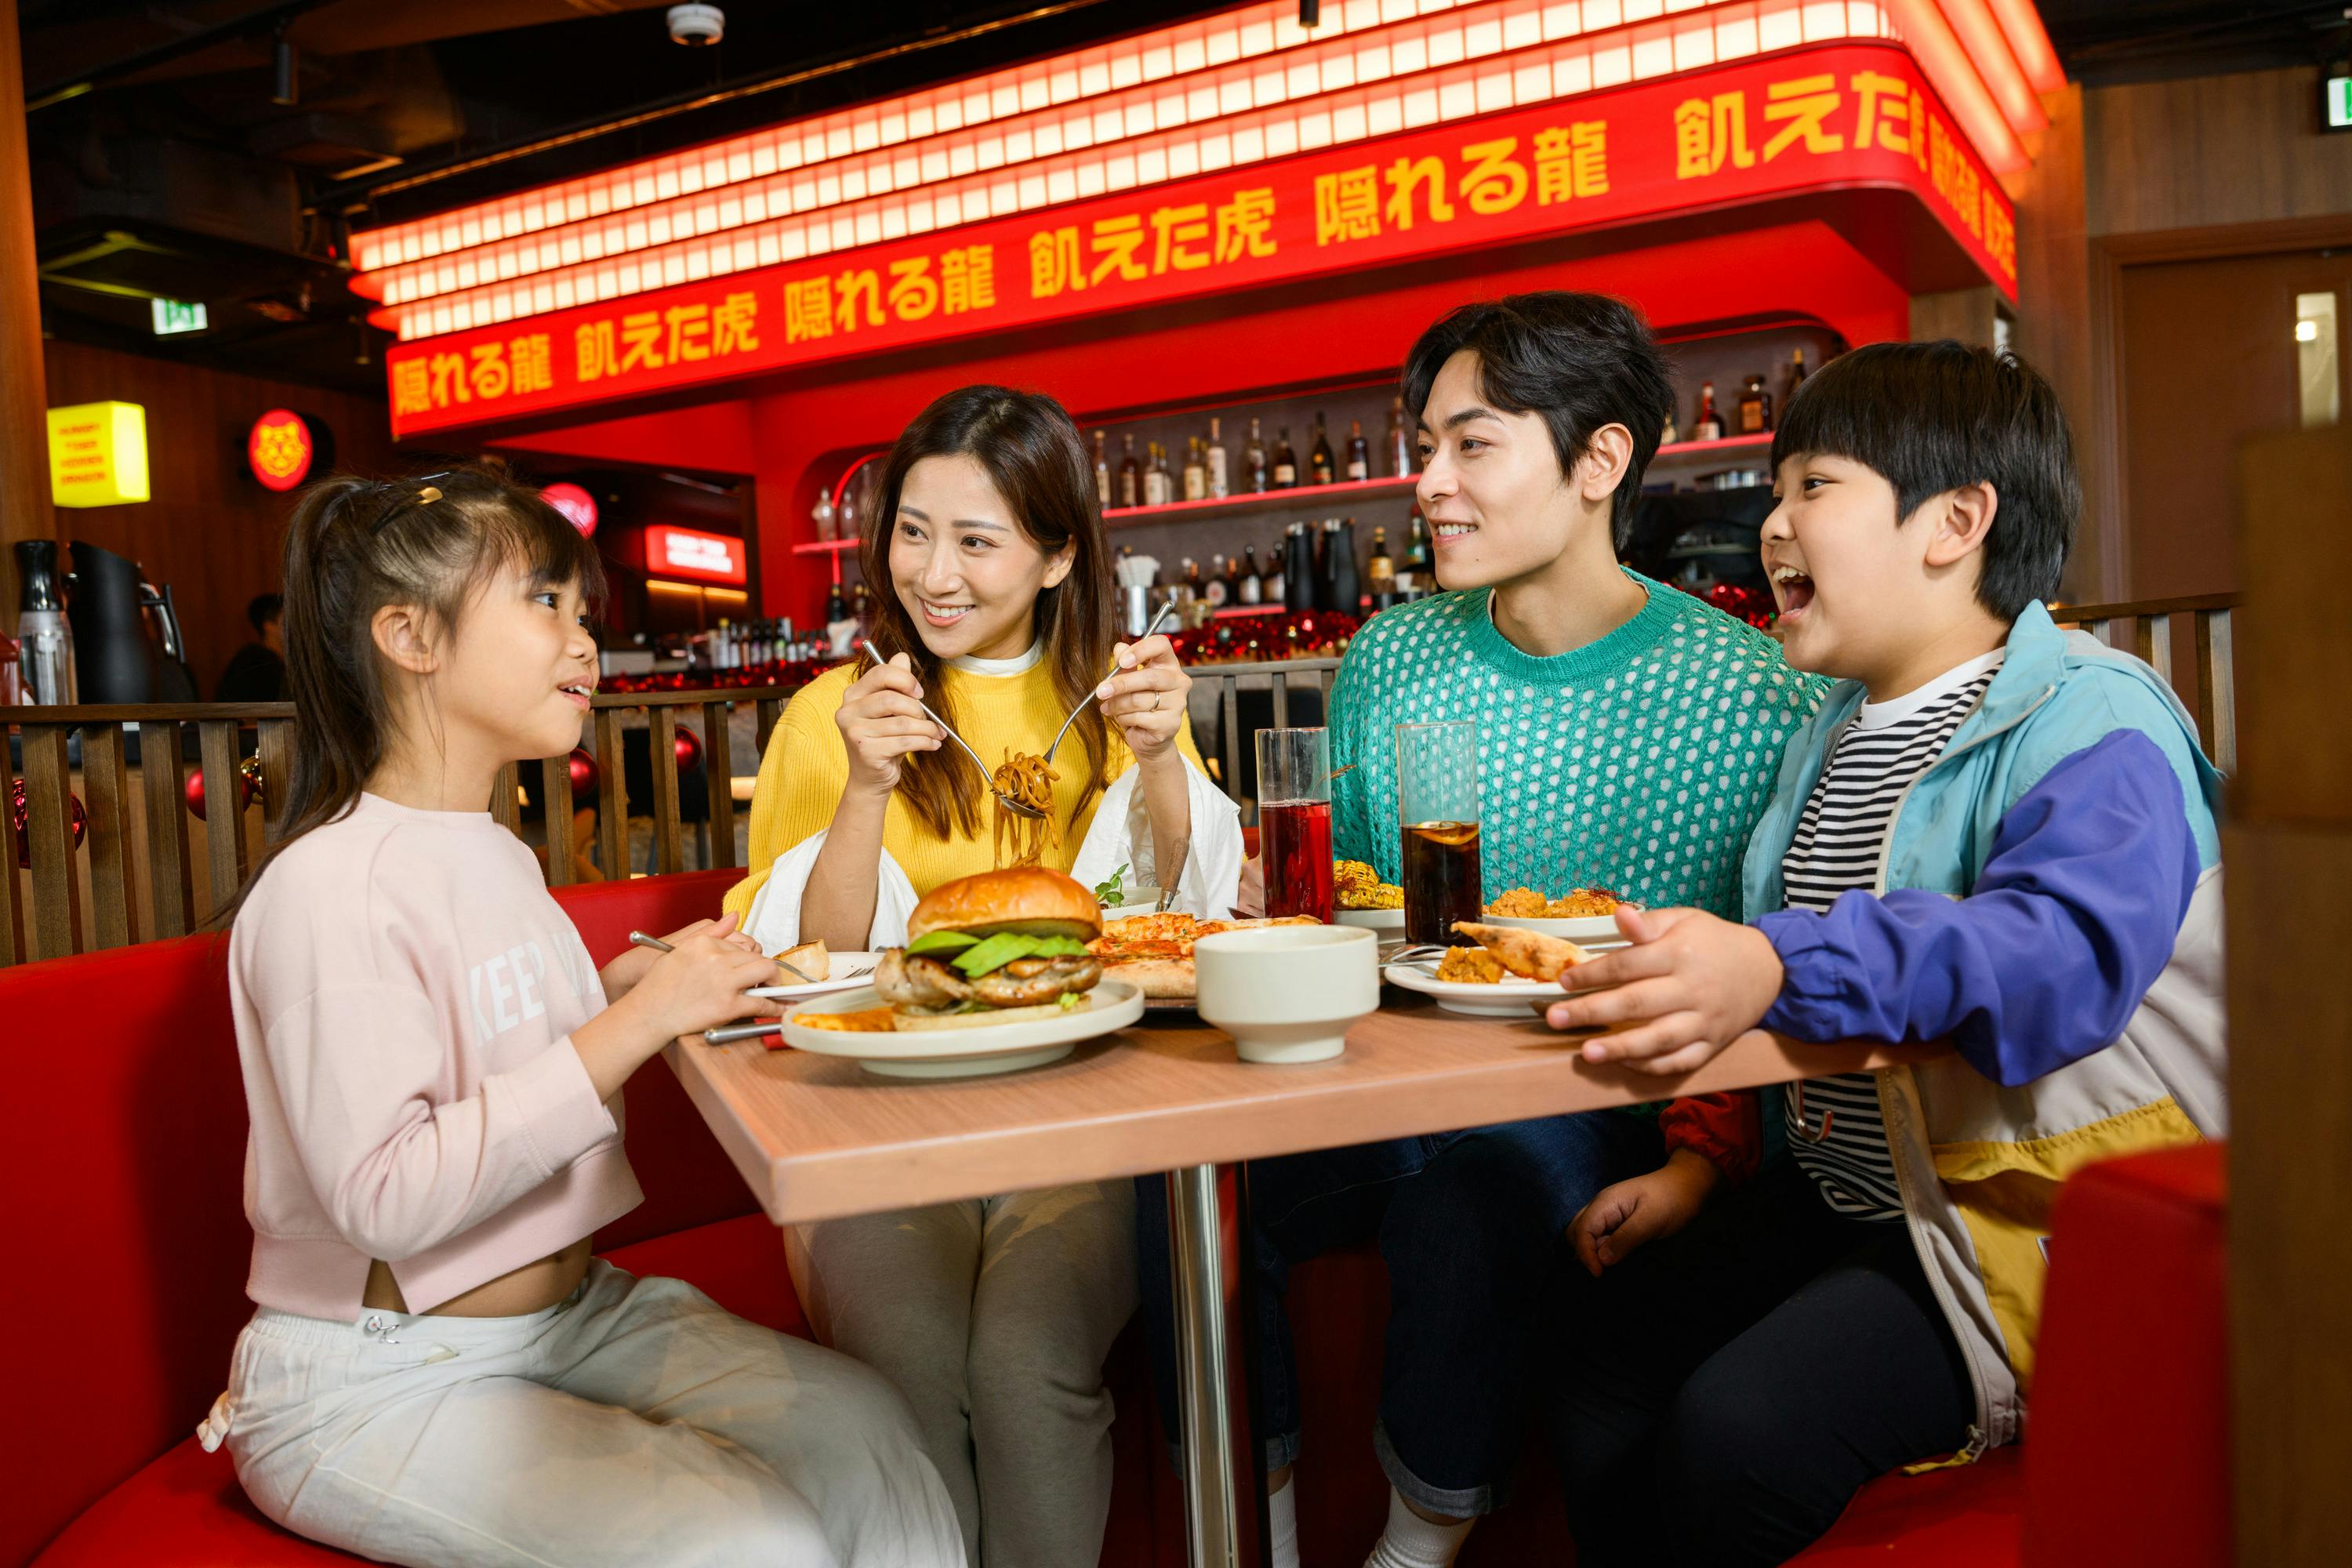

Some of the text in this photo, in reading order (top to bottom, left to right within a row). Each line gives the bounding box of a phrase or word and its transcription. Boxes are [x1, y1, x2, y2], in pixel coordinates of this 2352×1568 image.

[394, 332, 554, 415] 隠れる龍
[574, 292, 759, 382] 飢えた虎
[785, 245, 996, 343] 隠れる龍
[1029, 186, 1277, 298] 飢えた虎
[1314, 120, 1610, 247] 隠れる龍
[470, 940, 546, 1048] KEEP
